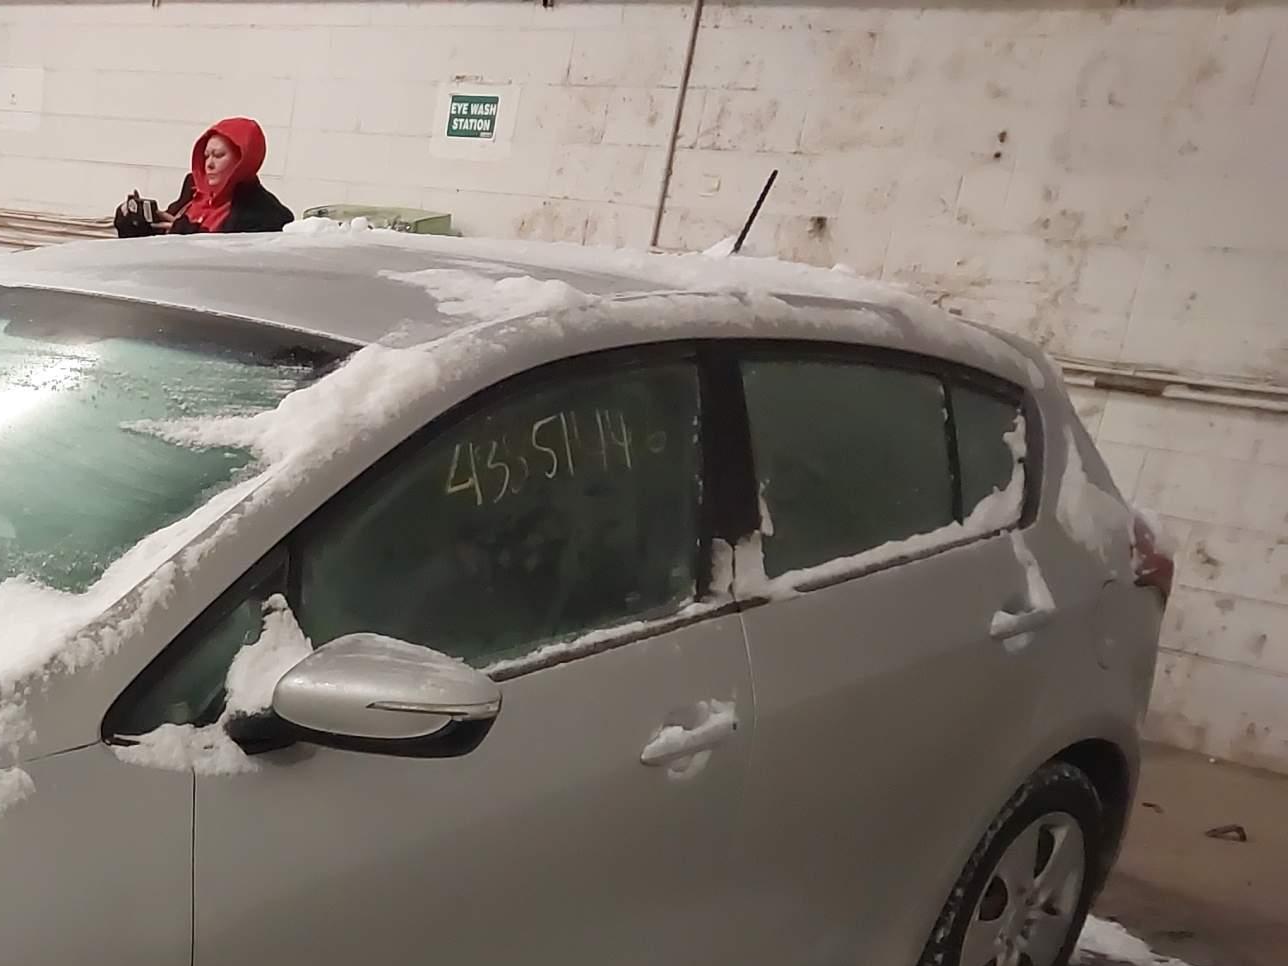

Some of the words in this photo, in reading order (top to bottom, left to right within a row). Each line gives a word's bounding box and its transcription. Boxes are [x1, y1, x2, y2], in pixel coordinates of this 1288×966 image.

[451, 102, 470, 115] EYE
[470, 103, 497, 116] WASH
[452, 118, 491, 131] STATION
